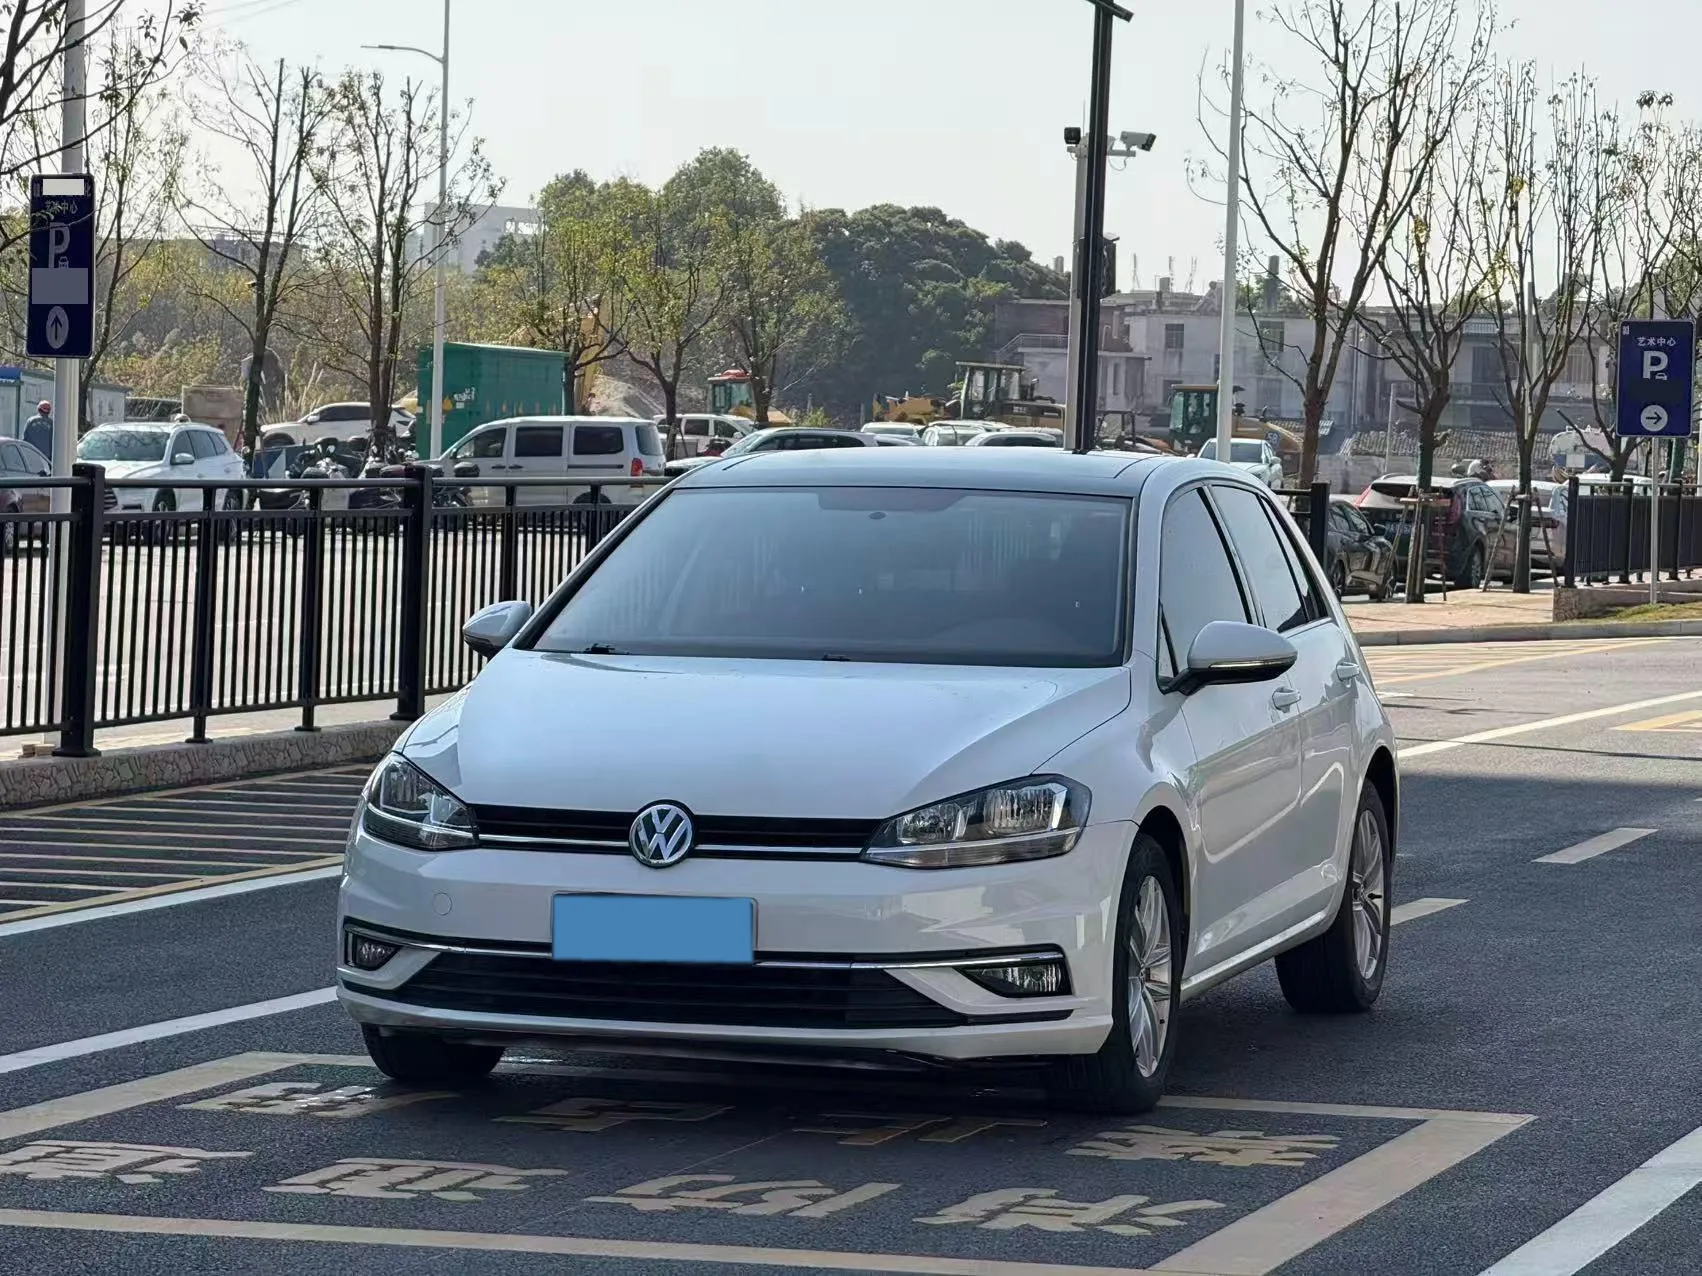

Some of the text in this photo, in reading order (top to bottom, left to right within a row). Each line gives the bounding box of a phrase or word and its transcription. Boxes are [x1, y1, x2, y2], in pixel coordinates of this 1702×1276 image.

[48, 222, 71, 268] P
[1637, 337, 1676, 346] 艺术中心
[1643, 351, 1668, 379] P
